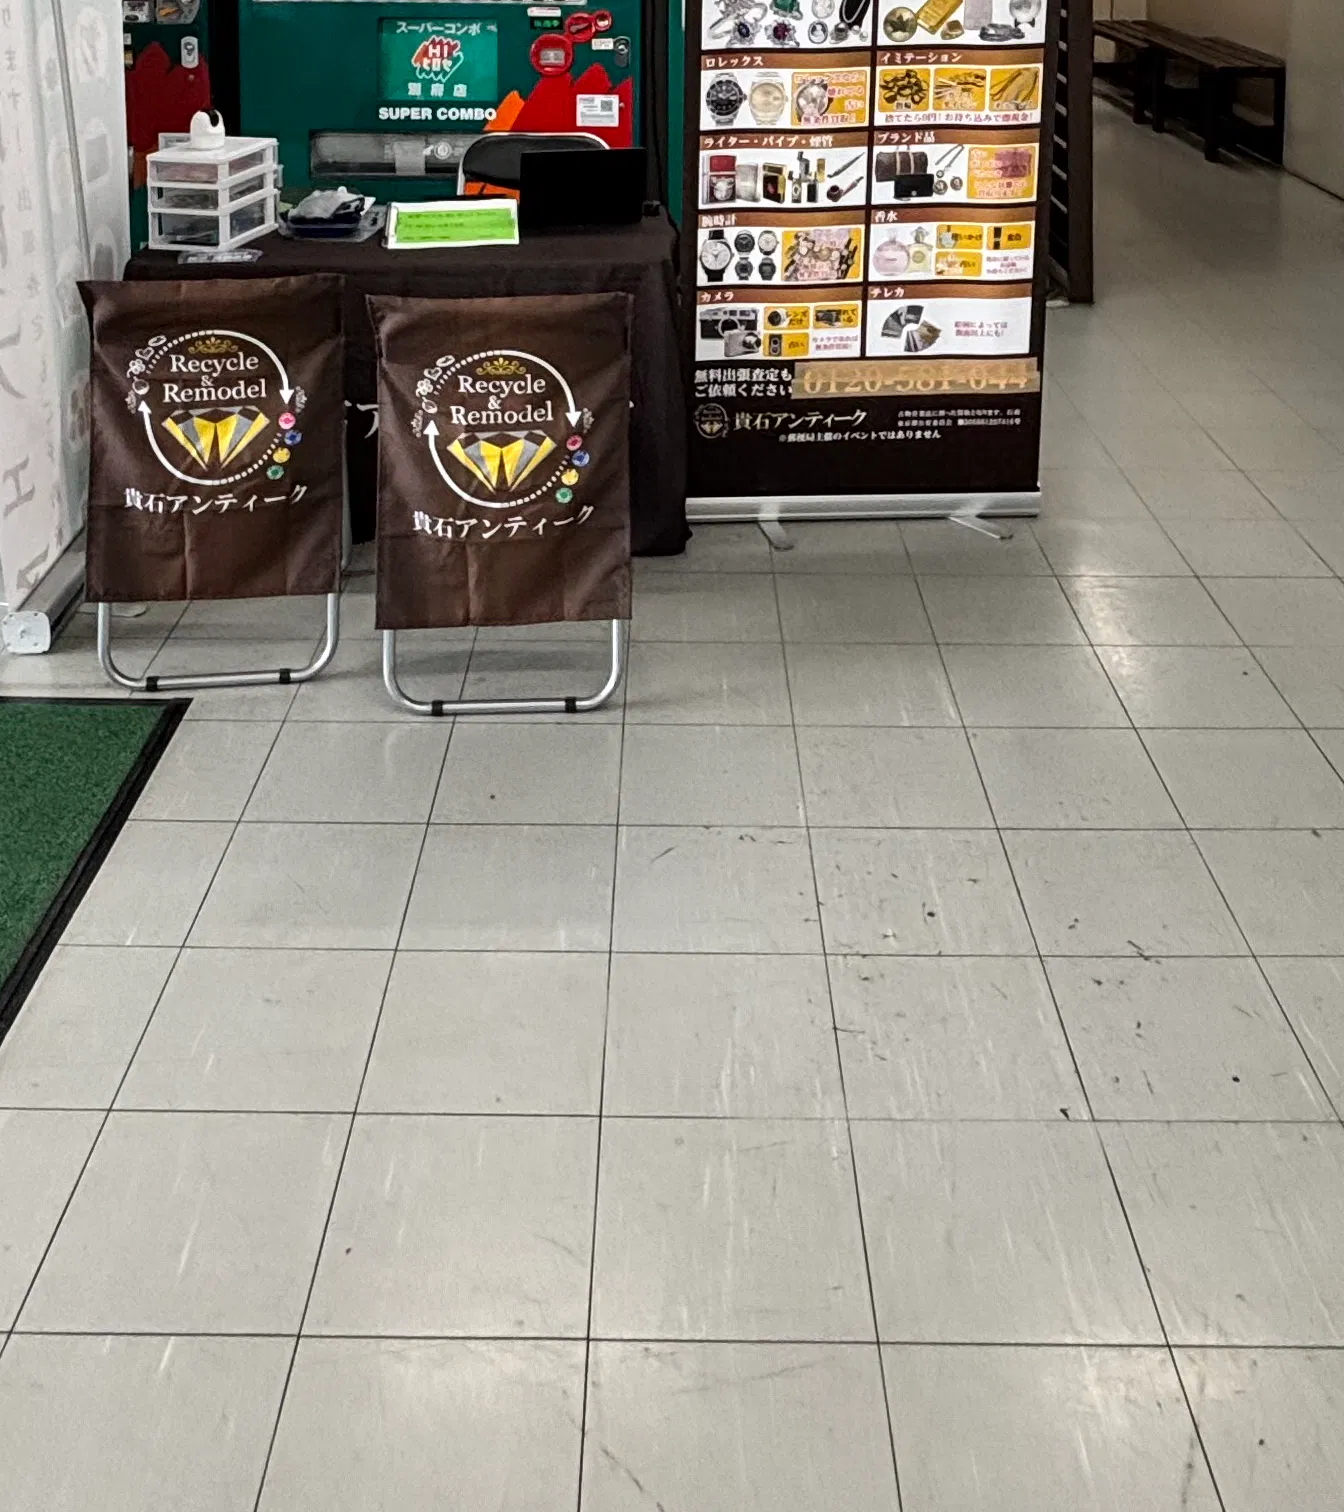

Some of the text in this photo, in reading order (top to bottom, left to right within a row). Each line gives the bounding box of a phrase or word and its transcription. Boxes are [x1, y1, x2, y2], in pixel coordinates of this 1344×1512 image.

[704, 55, 765, 69] ロレックス
[880, 52, 963, 65] イミテーション
[378, 107, 497, 121] SUPER COMBO
[877, 130, 936, 145] ブランド品
[700, 291, 734, 303] カメラ
[169, 351, 259, 376] Recycle
[201, 375, 214, 387] &
[694, 368, 793, 384] 無料出張査定も
[162, 378, 268, 404] Remodel
[457, 374, 547, 398] Recycle
[694, 383, 794, 398] ご依頼ください
[487, 395, 502, 410] &
[450, 400, 554, 426] Remodel
[733, 408, 868, 431] 貴石アンティーク
[123, 483, 309, 516] 貴石アンティーク
[411, 504, 595, 539] 貴石アンティーク
